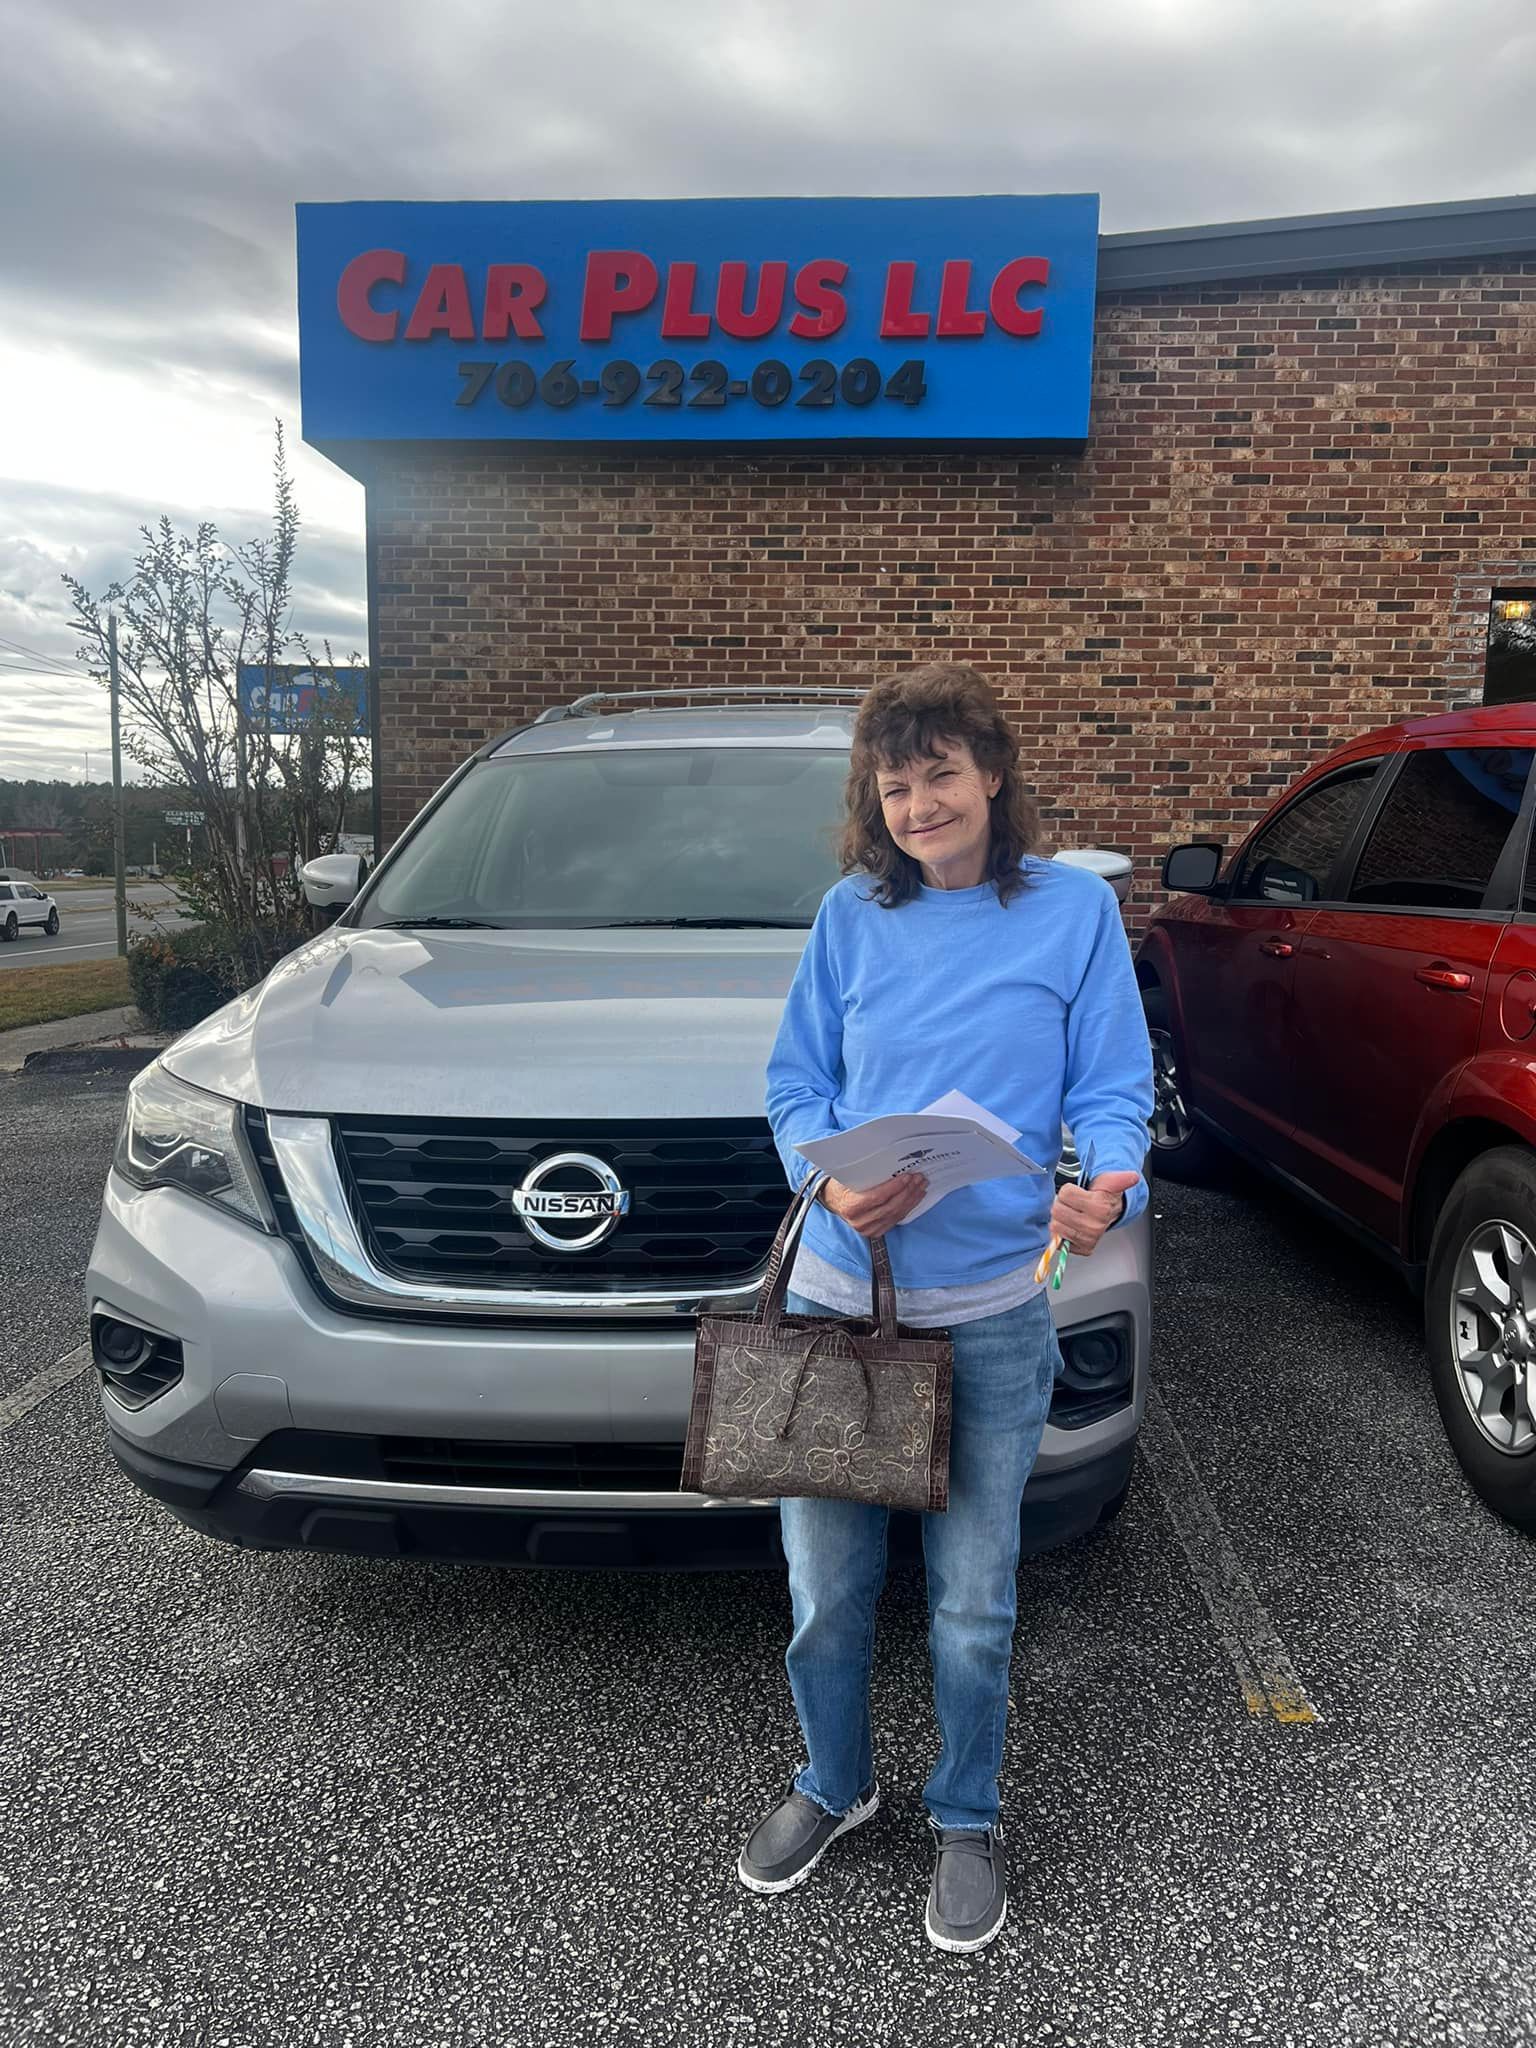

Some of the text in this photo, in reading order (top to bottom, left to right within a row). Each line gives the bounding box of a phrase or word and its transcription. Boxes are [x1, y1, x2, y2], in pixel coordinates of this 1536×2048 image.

[338, 250, 1050, 341] CAR PLUS LLC
[456, 358, 927, 409] 706-922-0204
[523, 1193, 616, 1214] NISSAN
